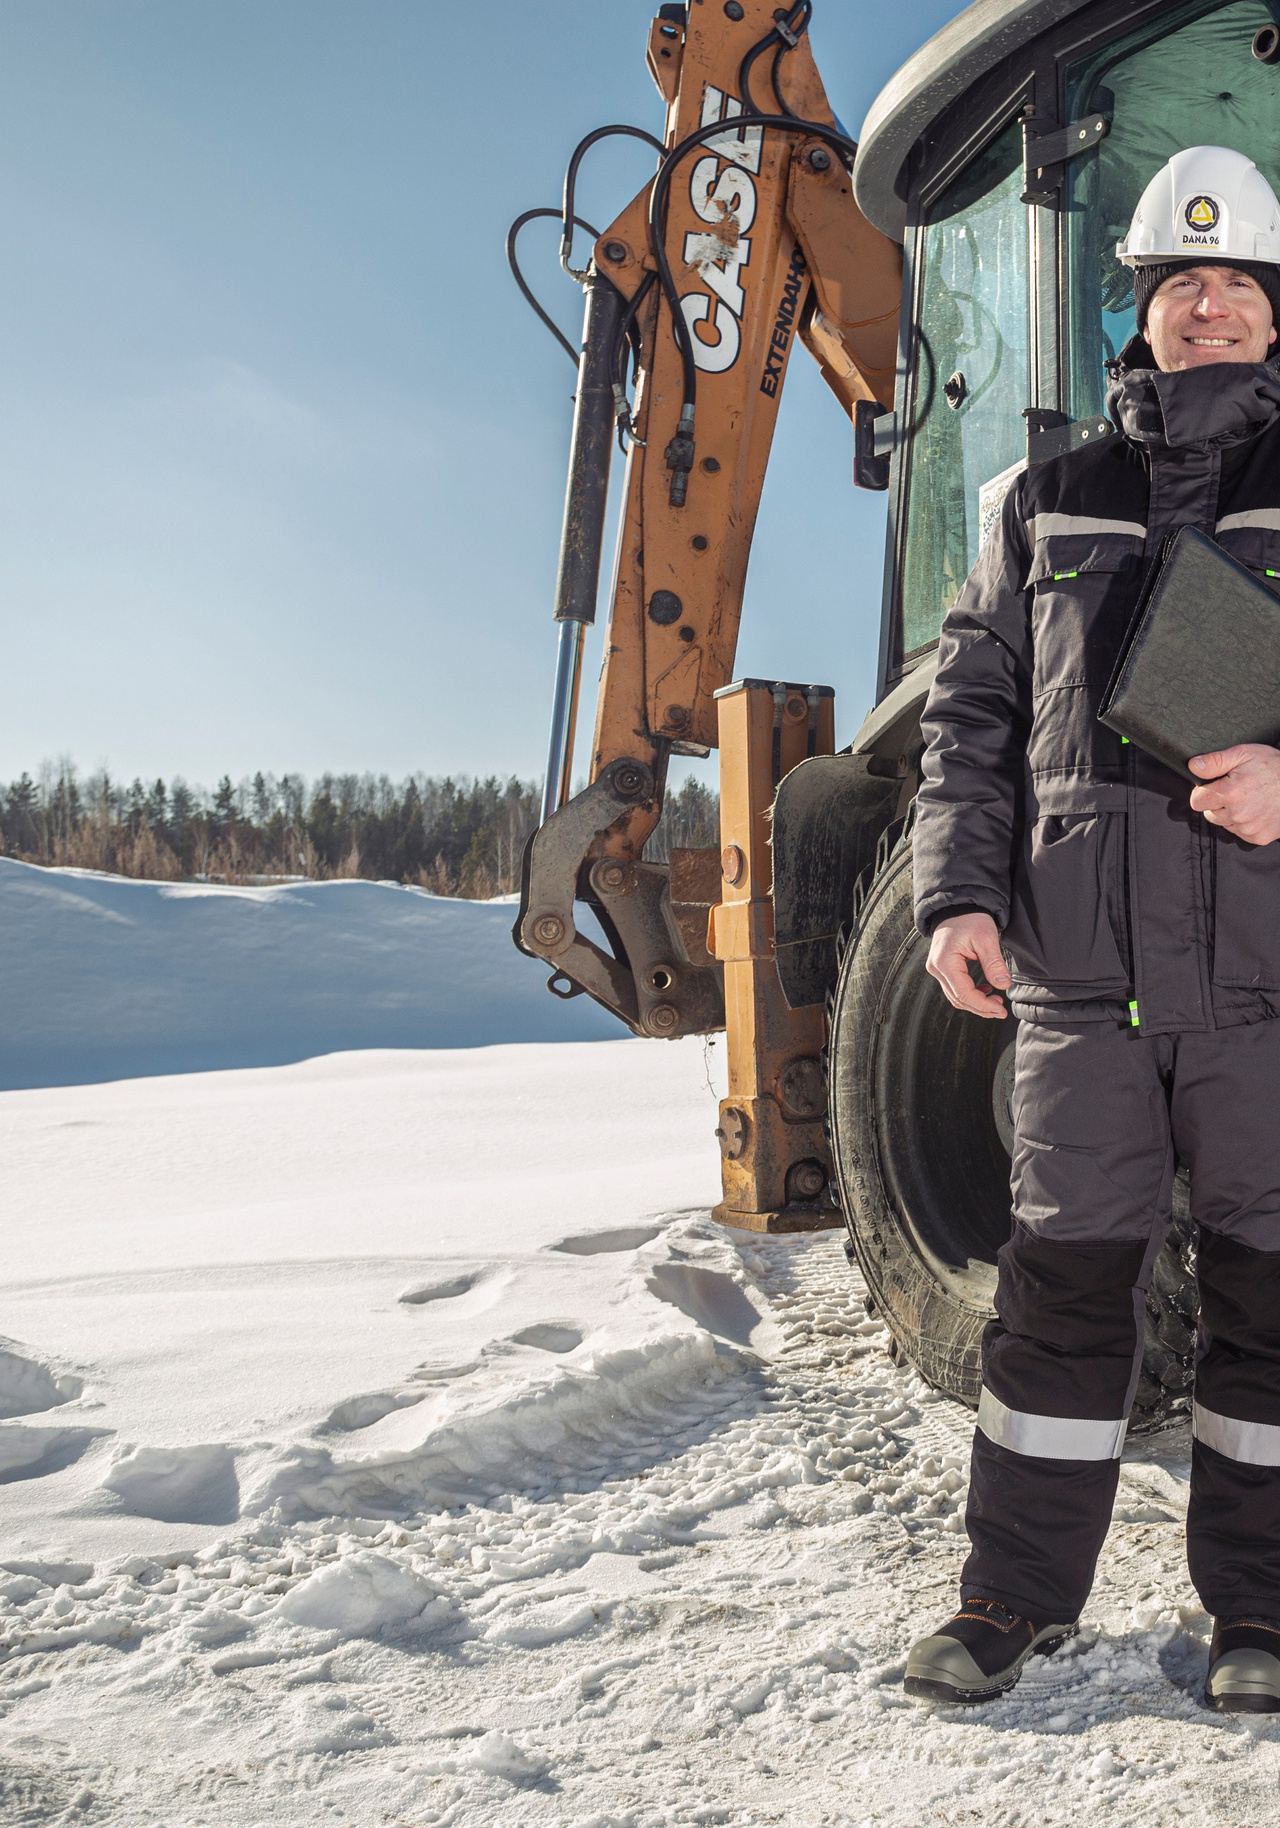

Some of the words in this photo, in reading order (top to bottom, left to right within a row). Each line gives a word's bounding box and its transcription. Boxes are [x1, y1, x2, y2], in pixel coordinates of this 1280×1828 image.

[673, 82, 765, 374] CASE
[1182, 234, 1208, 244] DANA
[1209, 236, 1220, 245] 96
